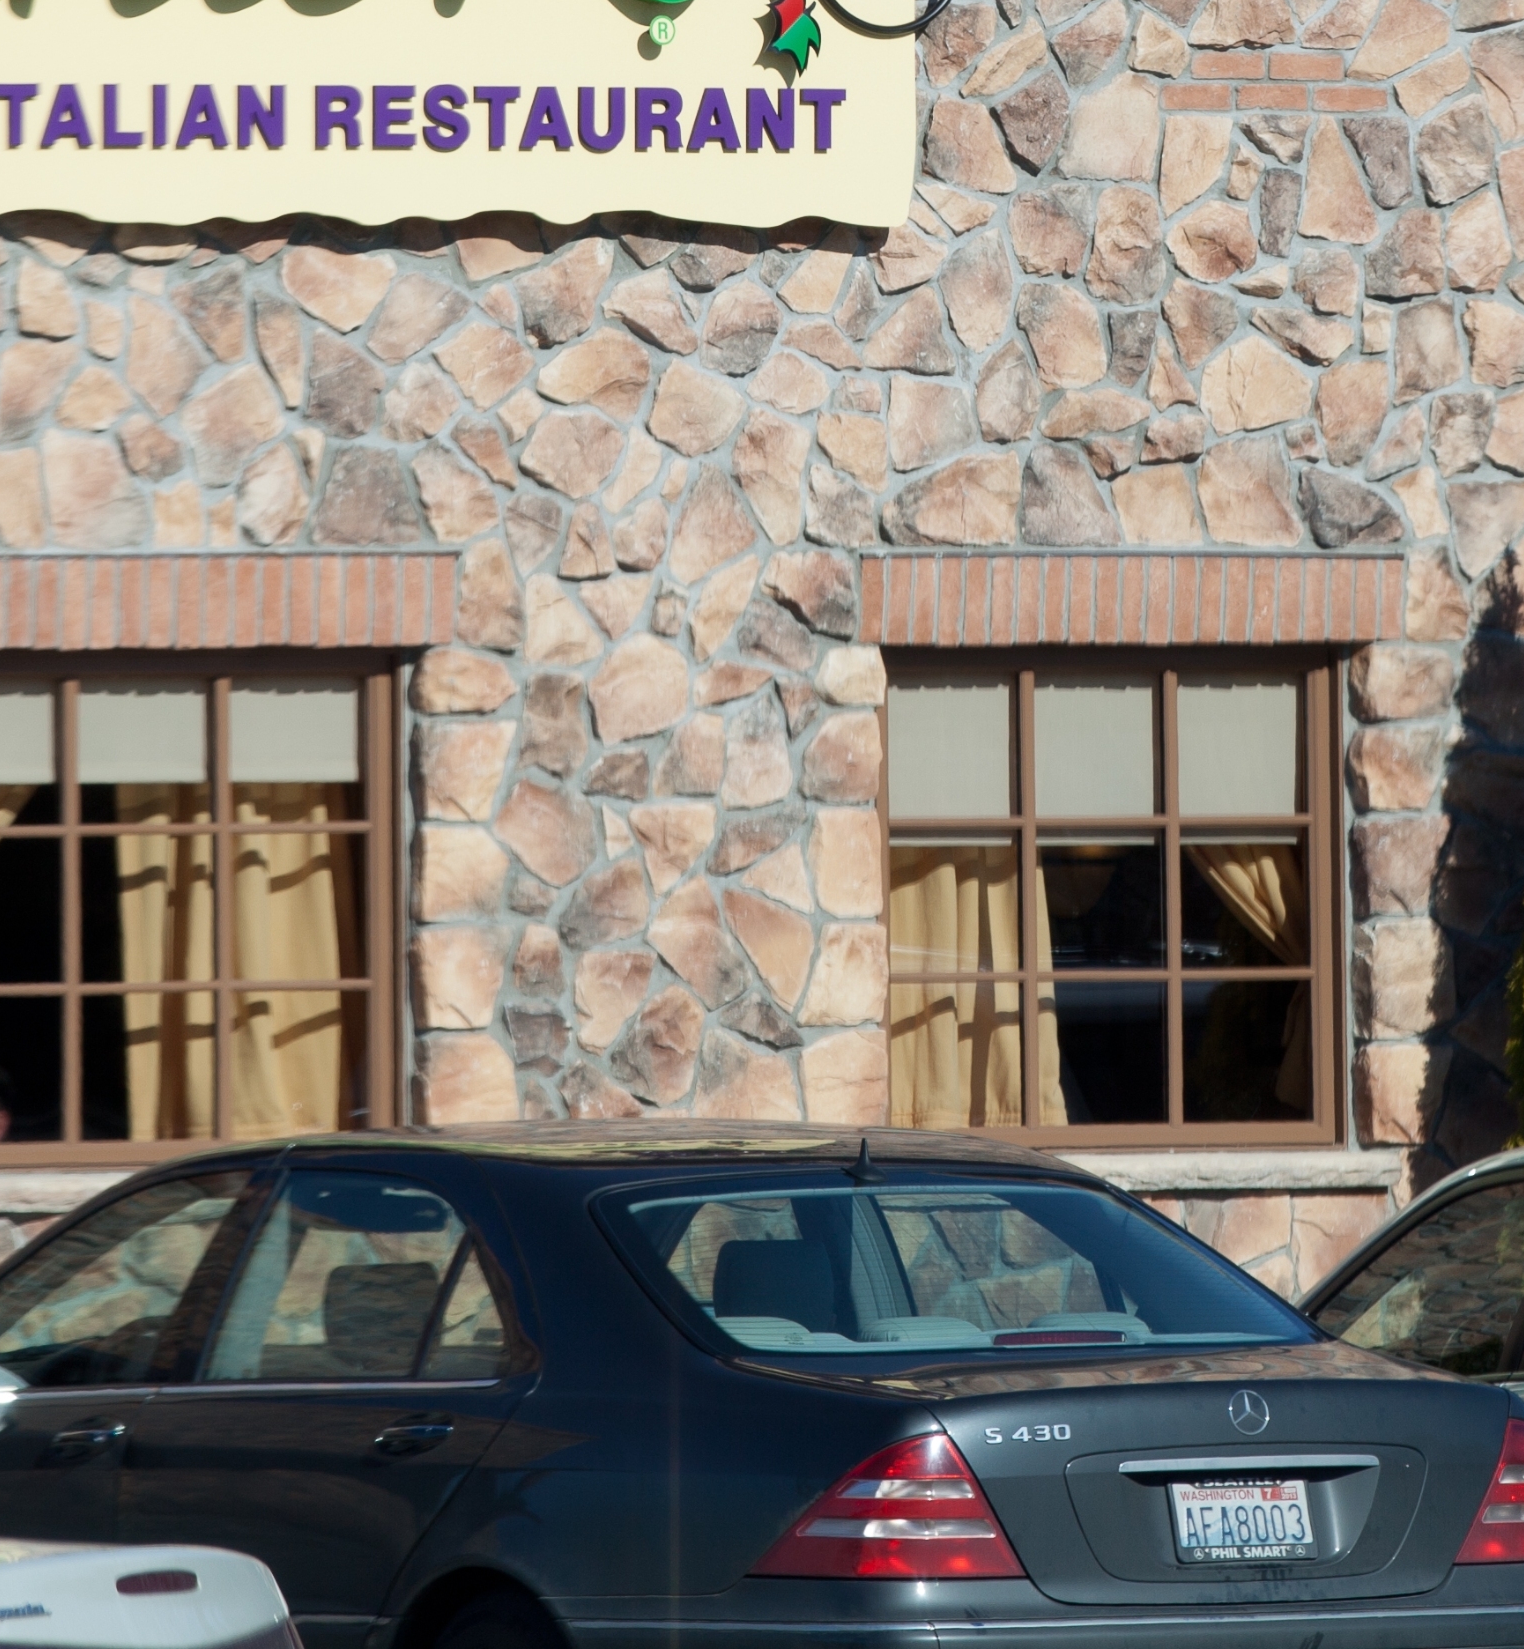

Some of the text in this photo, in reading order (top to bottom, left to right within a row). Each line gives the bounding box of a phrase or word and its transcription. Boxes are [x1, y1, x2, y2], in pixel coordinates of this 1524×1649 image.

[314, 84, 847, 154] RESTAURANT
[984, 1423, 1072, 1445] S 430
[1180, 1488, 1255, 1501] WASHINGTON
[1186, 1503, 1306, 1545] AFA8003
[1211, 1545, 1288, 1559] PHIL SMART
